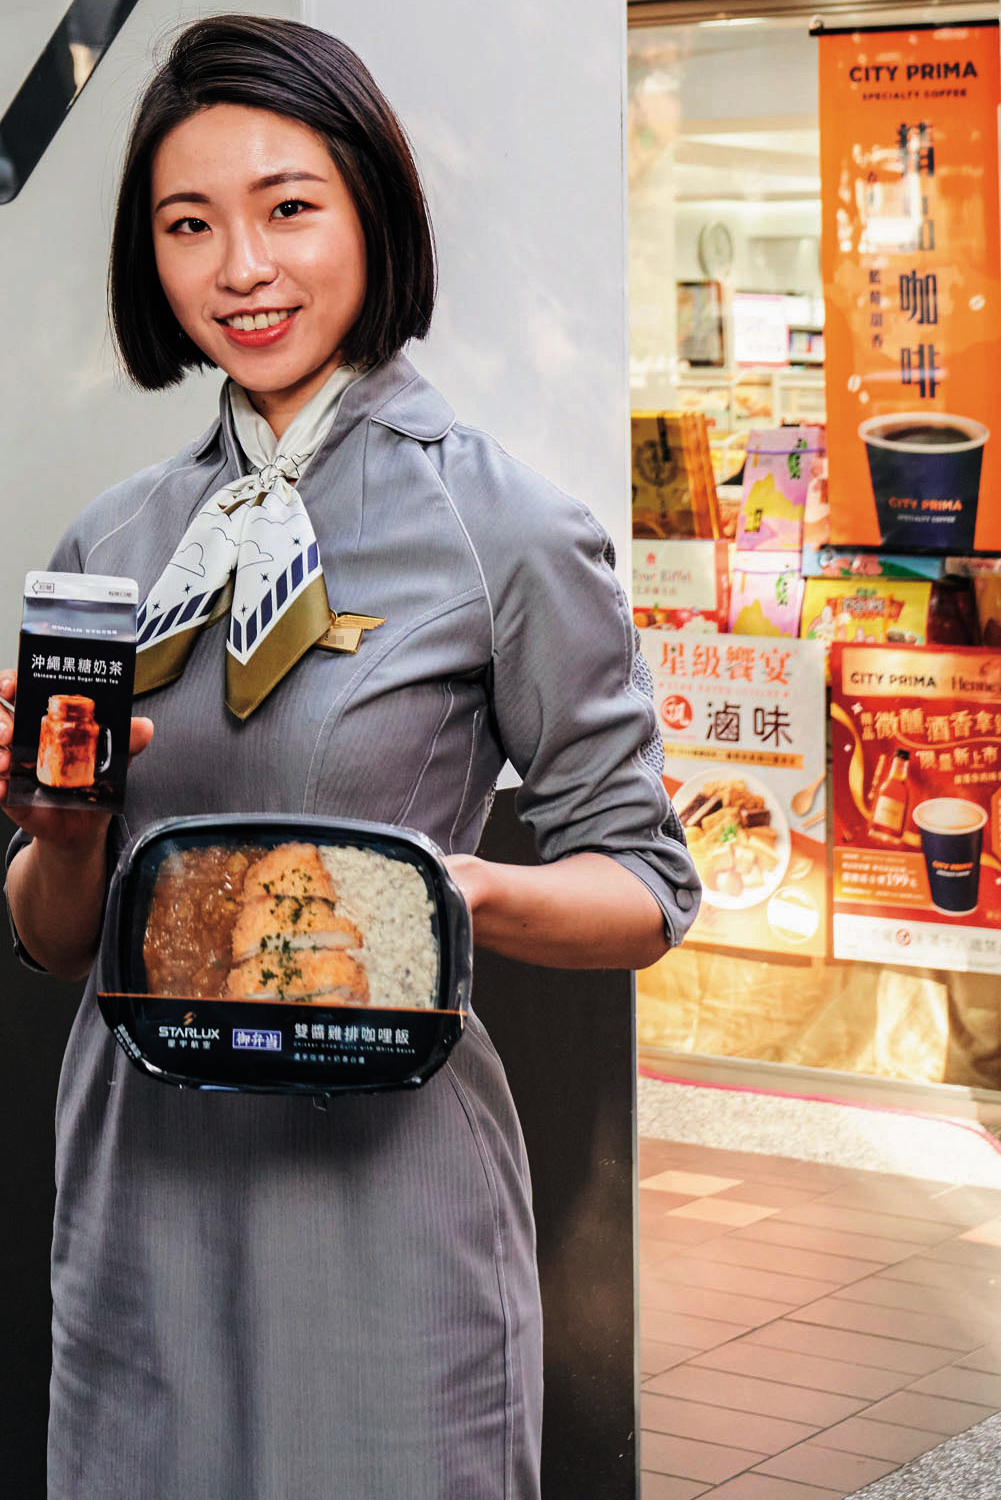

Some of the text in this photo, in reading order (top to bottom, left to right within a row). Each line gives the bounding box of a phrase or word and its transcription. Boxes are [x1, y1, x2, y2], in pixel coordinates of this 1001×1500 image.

[849, 60, 979, 83] CITY PRIMA
[921, 499, 963, 512] PRIMA
[31, 653, 123, 676] 沖繩黑糖奶茶
[850, 671, 884, 684] CITY
[889, 675, 937, 689] PRIMA
[705, 700, 793, 748] 滷味
[158, 1025, 220, 1040] STARLUX
